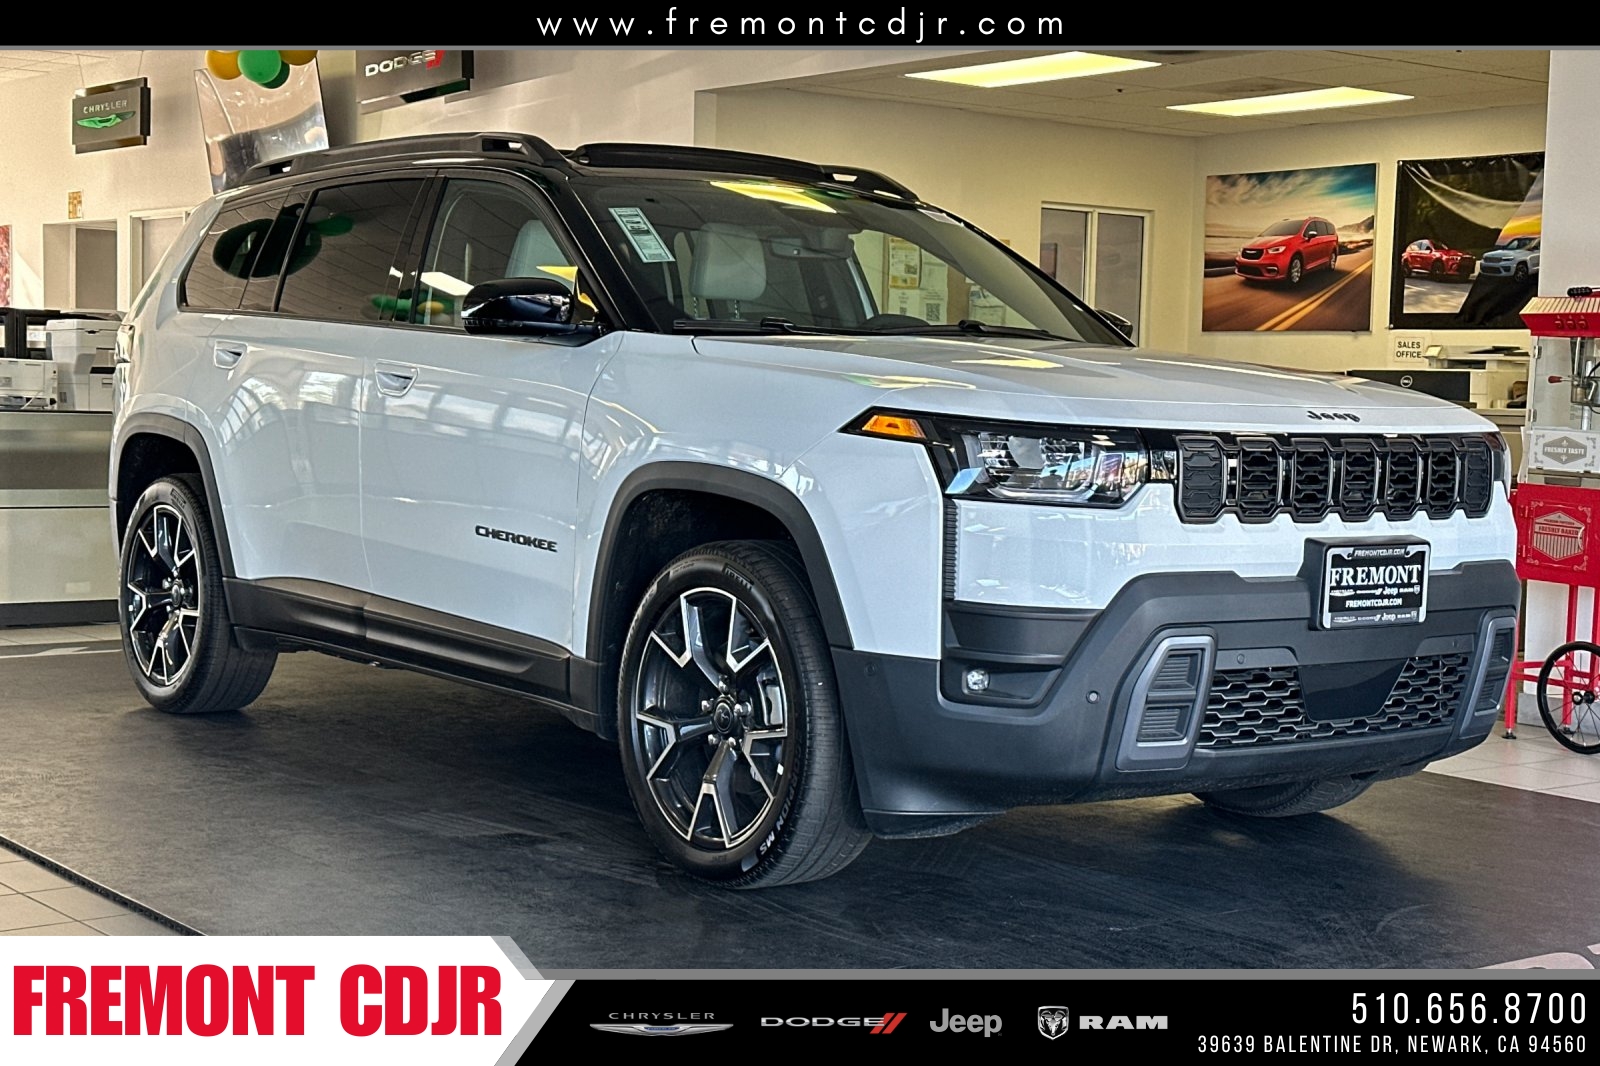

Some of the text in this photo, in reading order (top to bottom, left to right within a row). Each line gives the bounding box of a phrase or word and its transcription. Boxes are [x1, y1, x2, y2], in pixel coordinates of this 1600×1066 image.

[365, 50, 436, 76] DODGE
[83, 99, 128, 114] CHRYSLER
[1397, 341, 1421, 349] SALES
[1396, 350, 1422, 358] OFFICE
[1307, 410, 1361, 423] Jeep
[1568, 447, 1585, 455] TASTE
[1538, 525, 1560, 534] FRESHLY
[475, 525, 558, 553] CHEROKEE
[1354, 548, 1405, 557] FREMONTCDJR.COM
[1330, 565, 1421, 586] FREMONT
[1383, 586, 1398, 595] Jeep
[1345, 598, 1403, 608] FREMONTCDJR.COM
